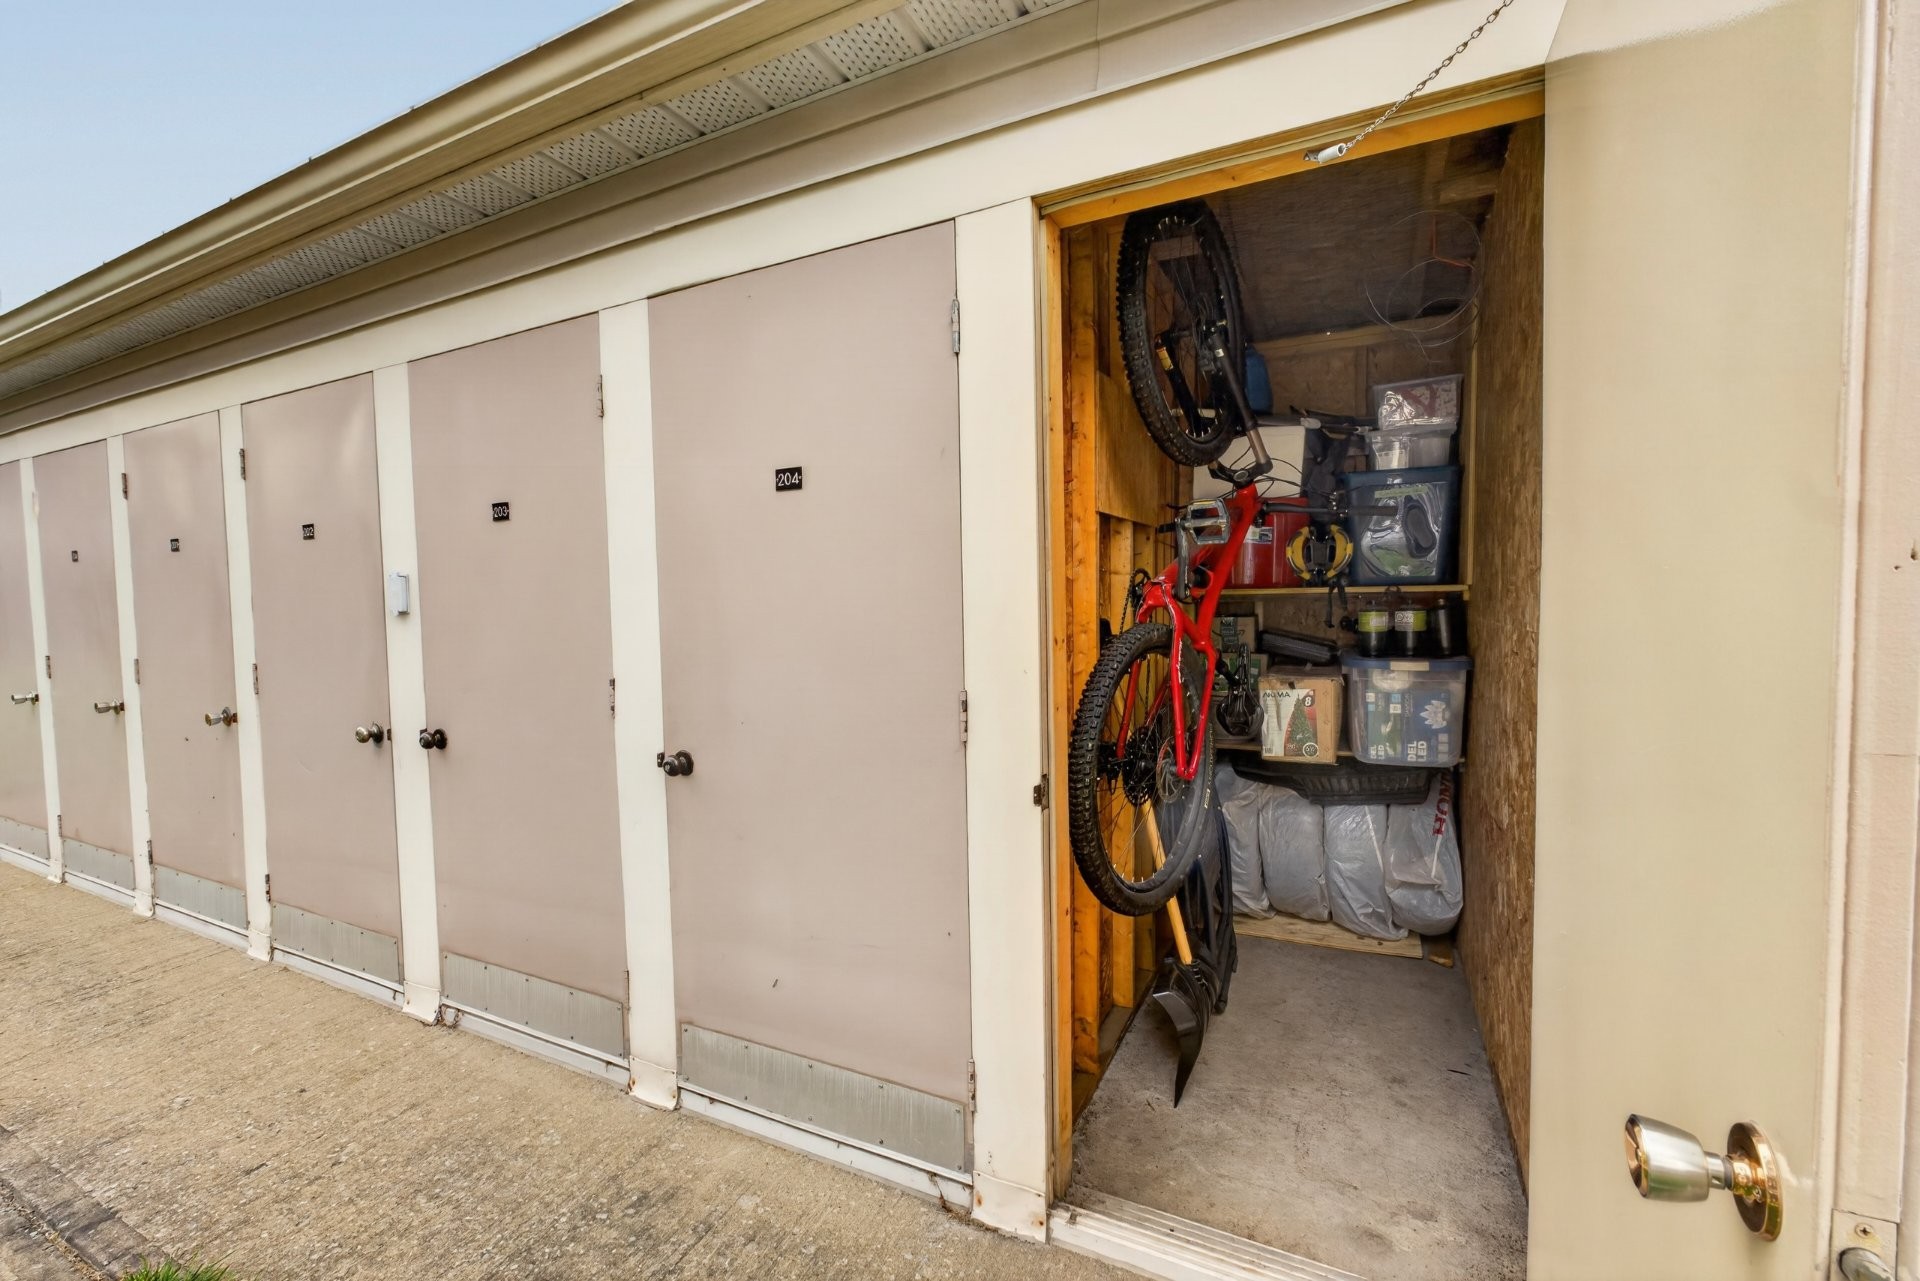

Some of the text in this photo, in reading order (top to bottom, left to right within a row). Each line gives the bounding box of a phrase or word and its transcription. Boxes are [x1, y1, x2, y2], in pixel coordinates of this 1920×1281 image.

[778, 472, 800, 487] 204
[493, 506, 508, 517] 203
[1304, 696, 1312, 706] 8
[1407, 741, 1417, 762] DEL
[1418, 741, 1427, 762] LED
